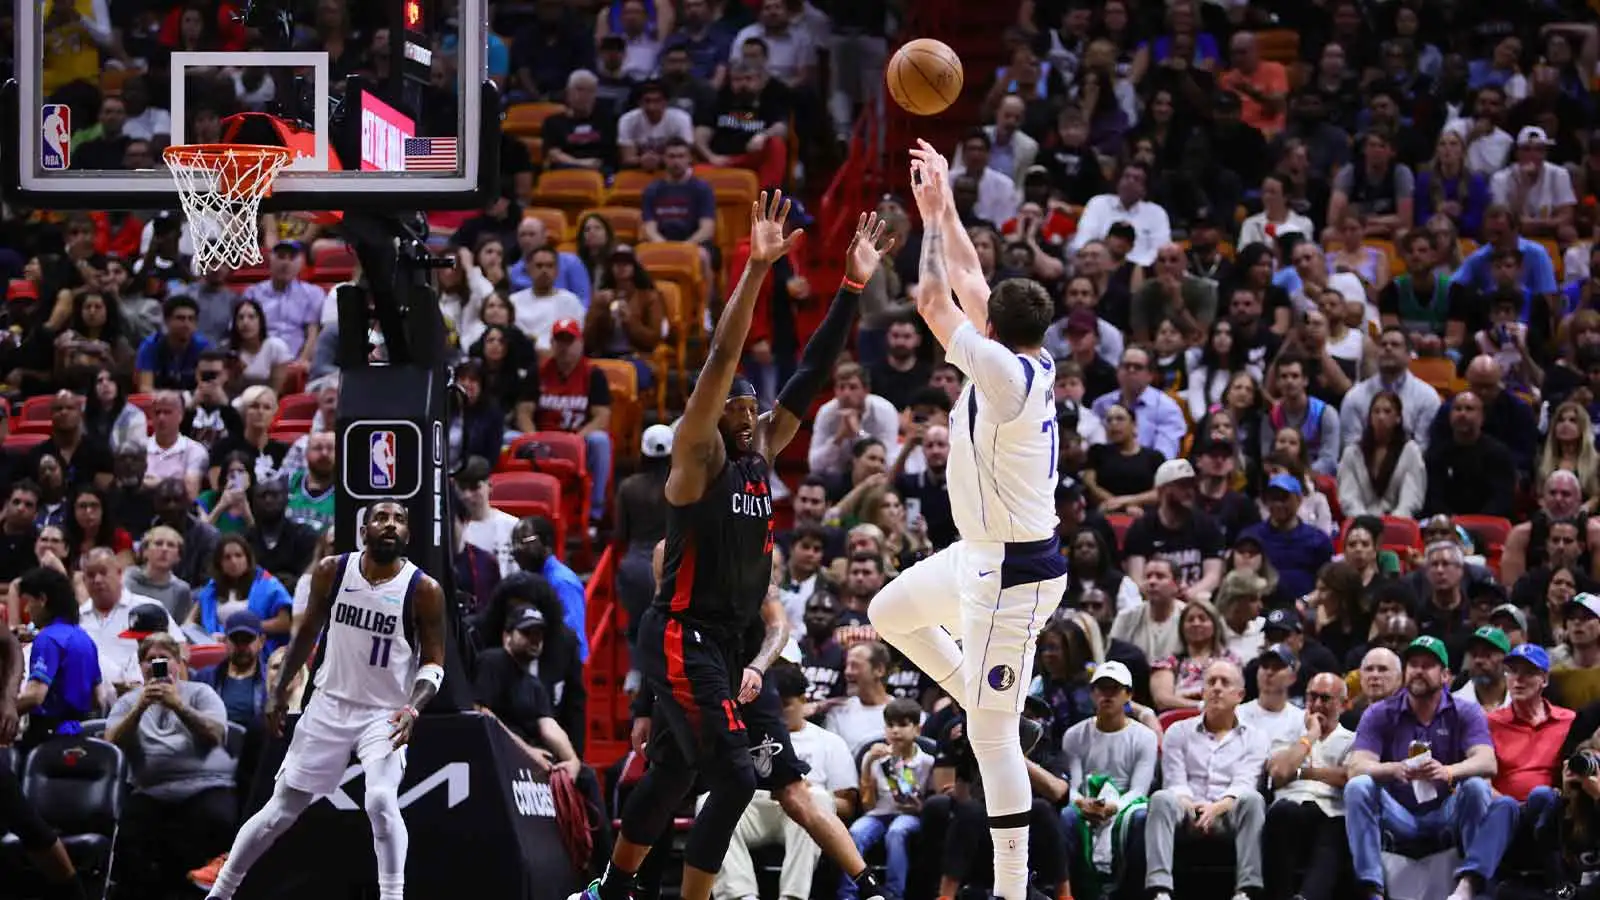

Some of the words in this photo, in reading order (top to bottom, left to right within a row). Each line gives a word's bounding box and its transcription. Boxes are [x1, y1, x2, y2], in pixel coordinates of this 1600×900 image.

[44, 154, 60, 166] NBA
[538, 394, 589, 411] MIAMI
[334, 602, 398, 635] DALLAS
[369, 635, 394, 669] 11
